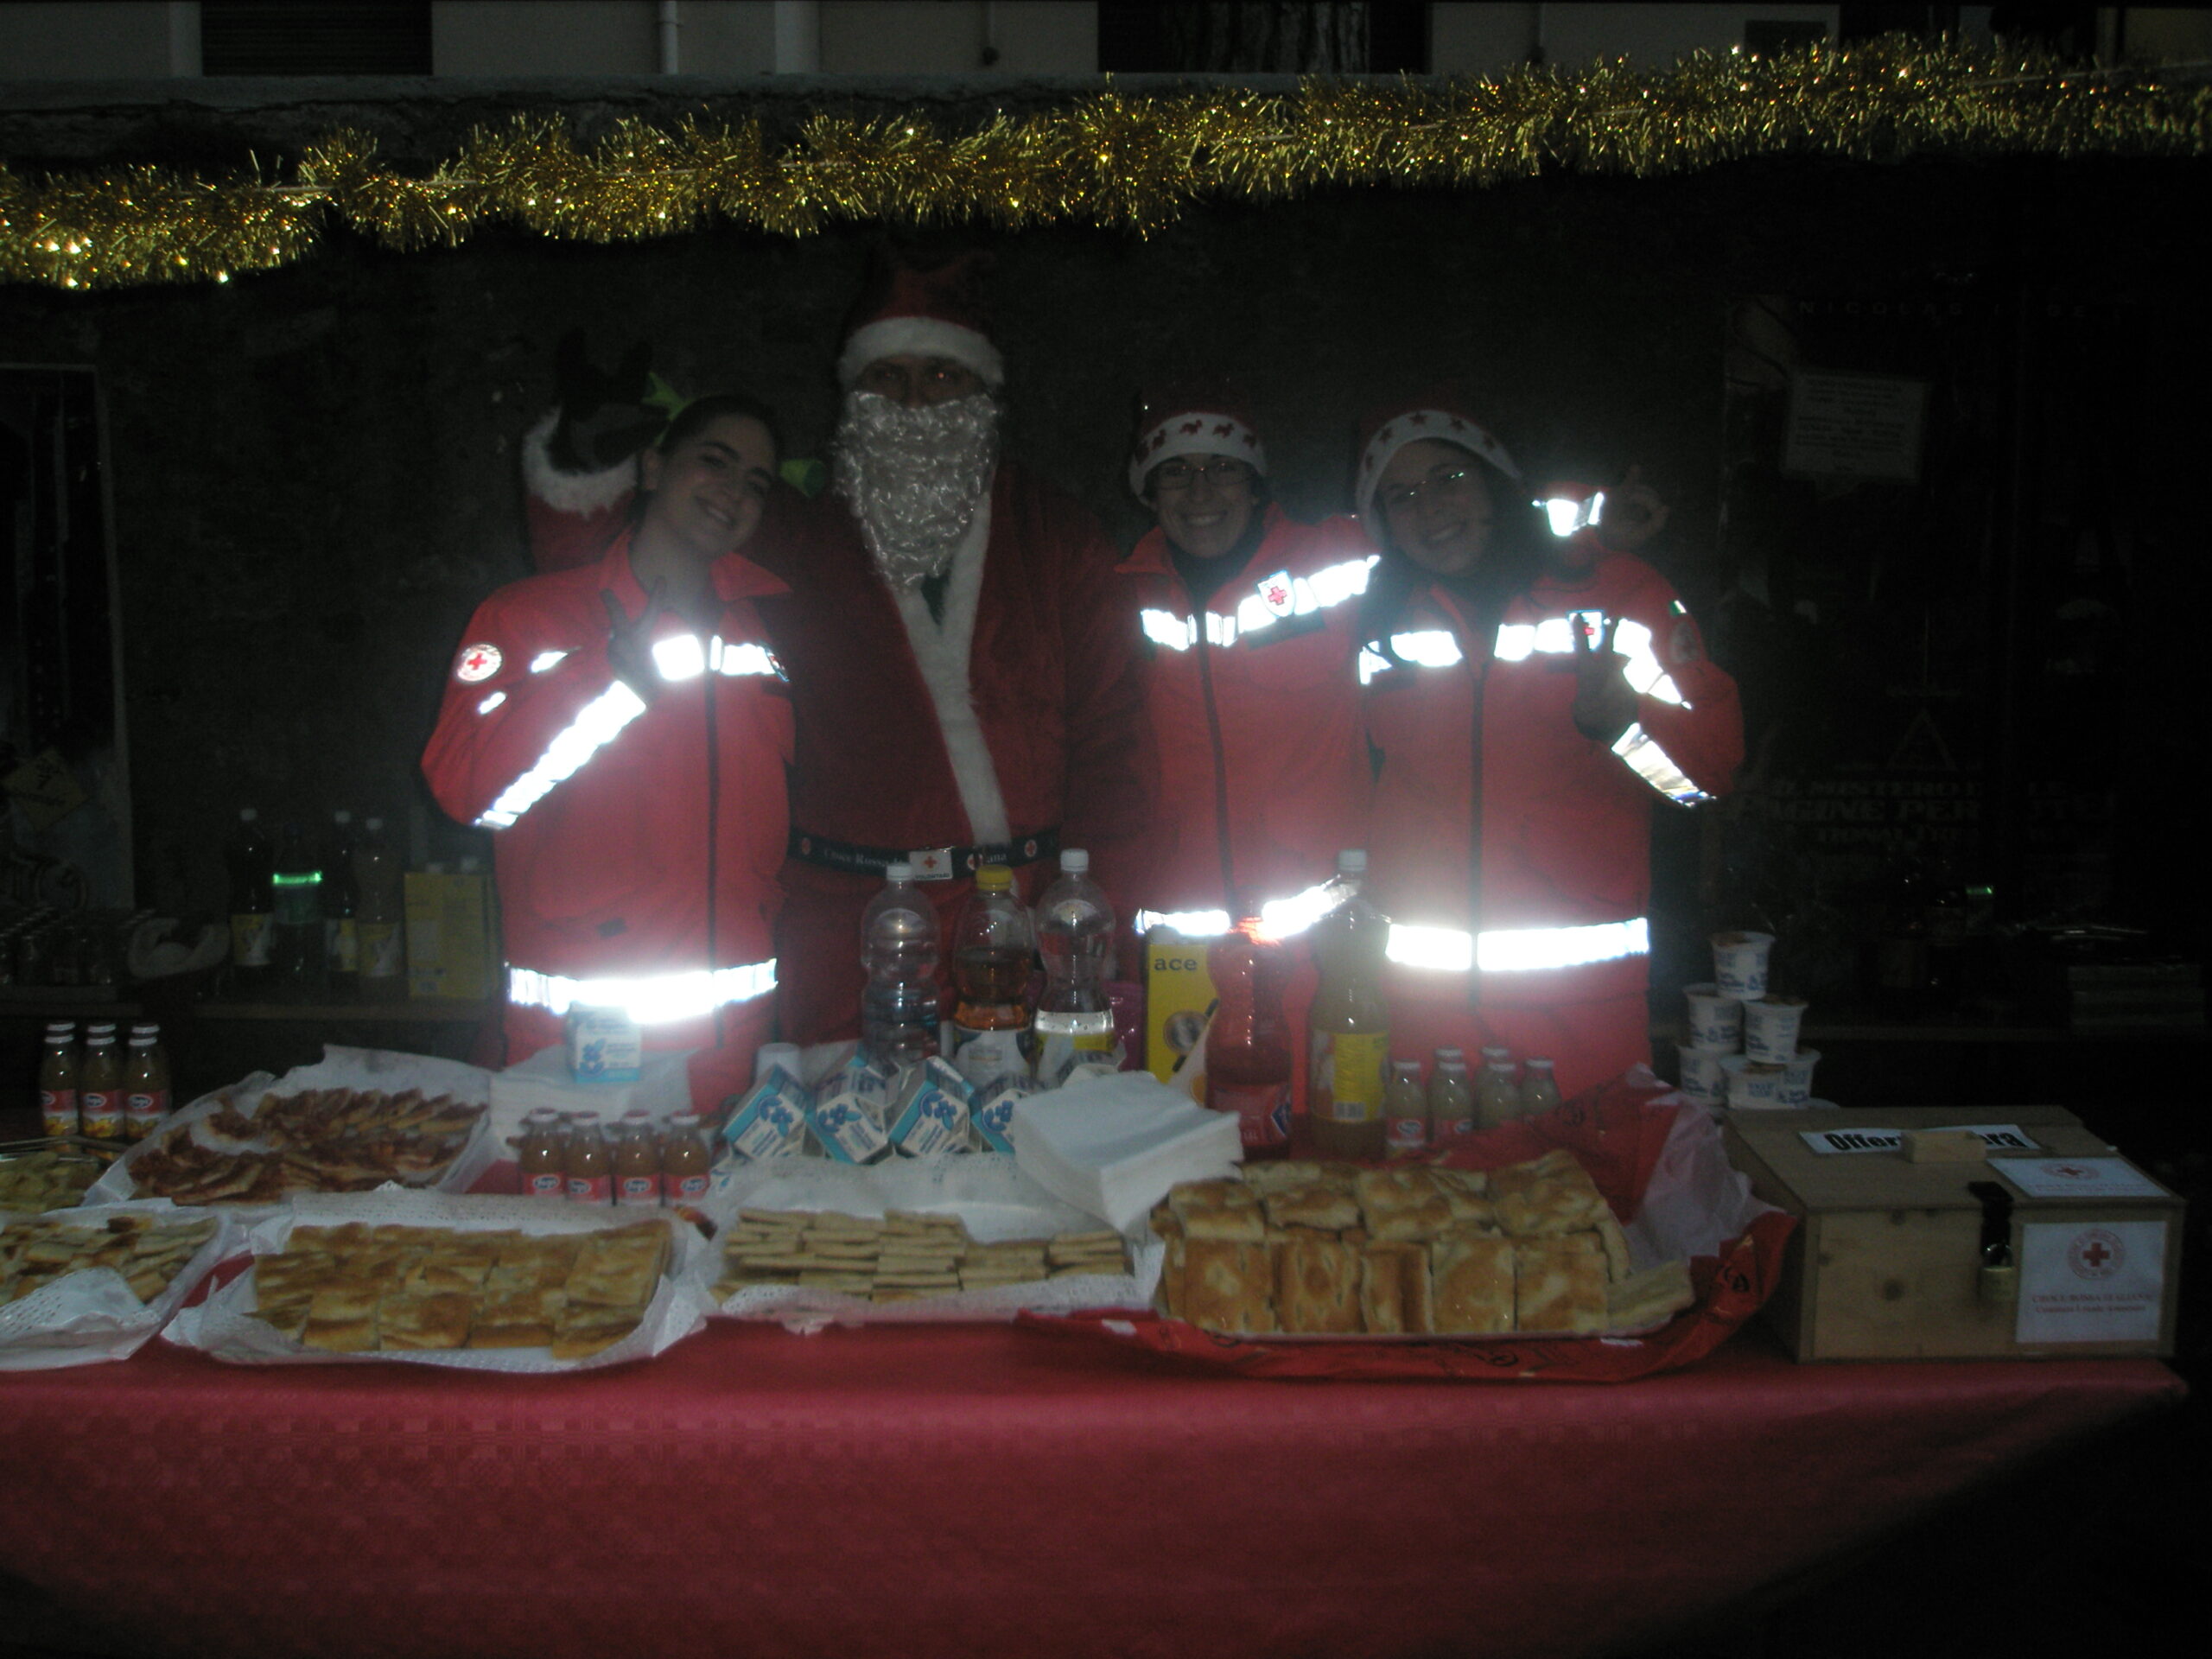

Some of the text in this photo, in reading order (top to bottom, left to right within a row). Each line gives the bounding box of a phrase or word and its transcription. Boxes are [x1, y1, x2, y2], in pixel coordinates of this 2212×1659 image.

[1798, 300, 1962, 317] NICOLAS
[1154, 957, 1198, 972] ace
[1824, 1133, 1902, 1150] Offer
